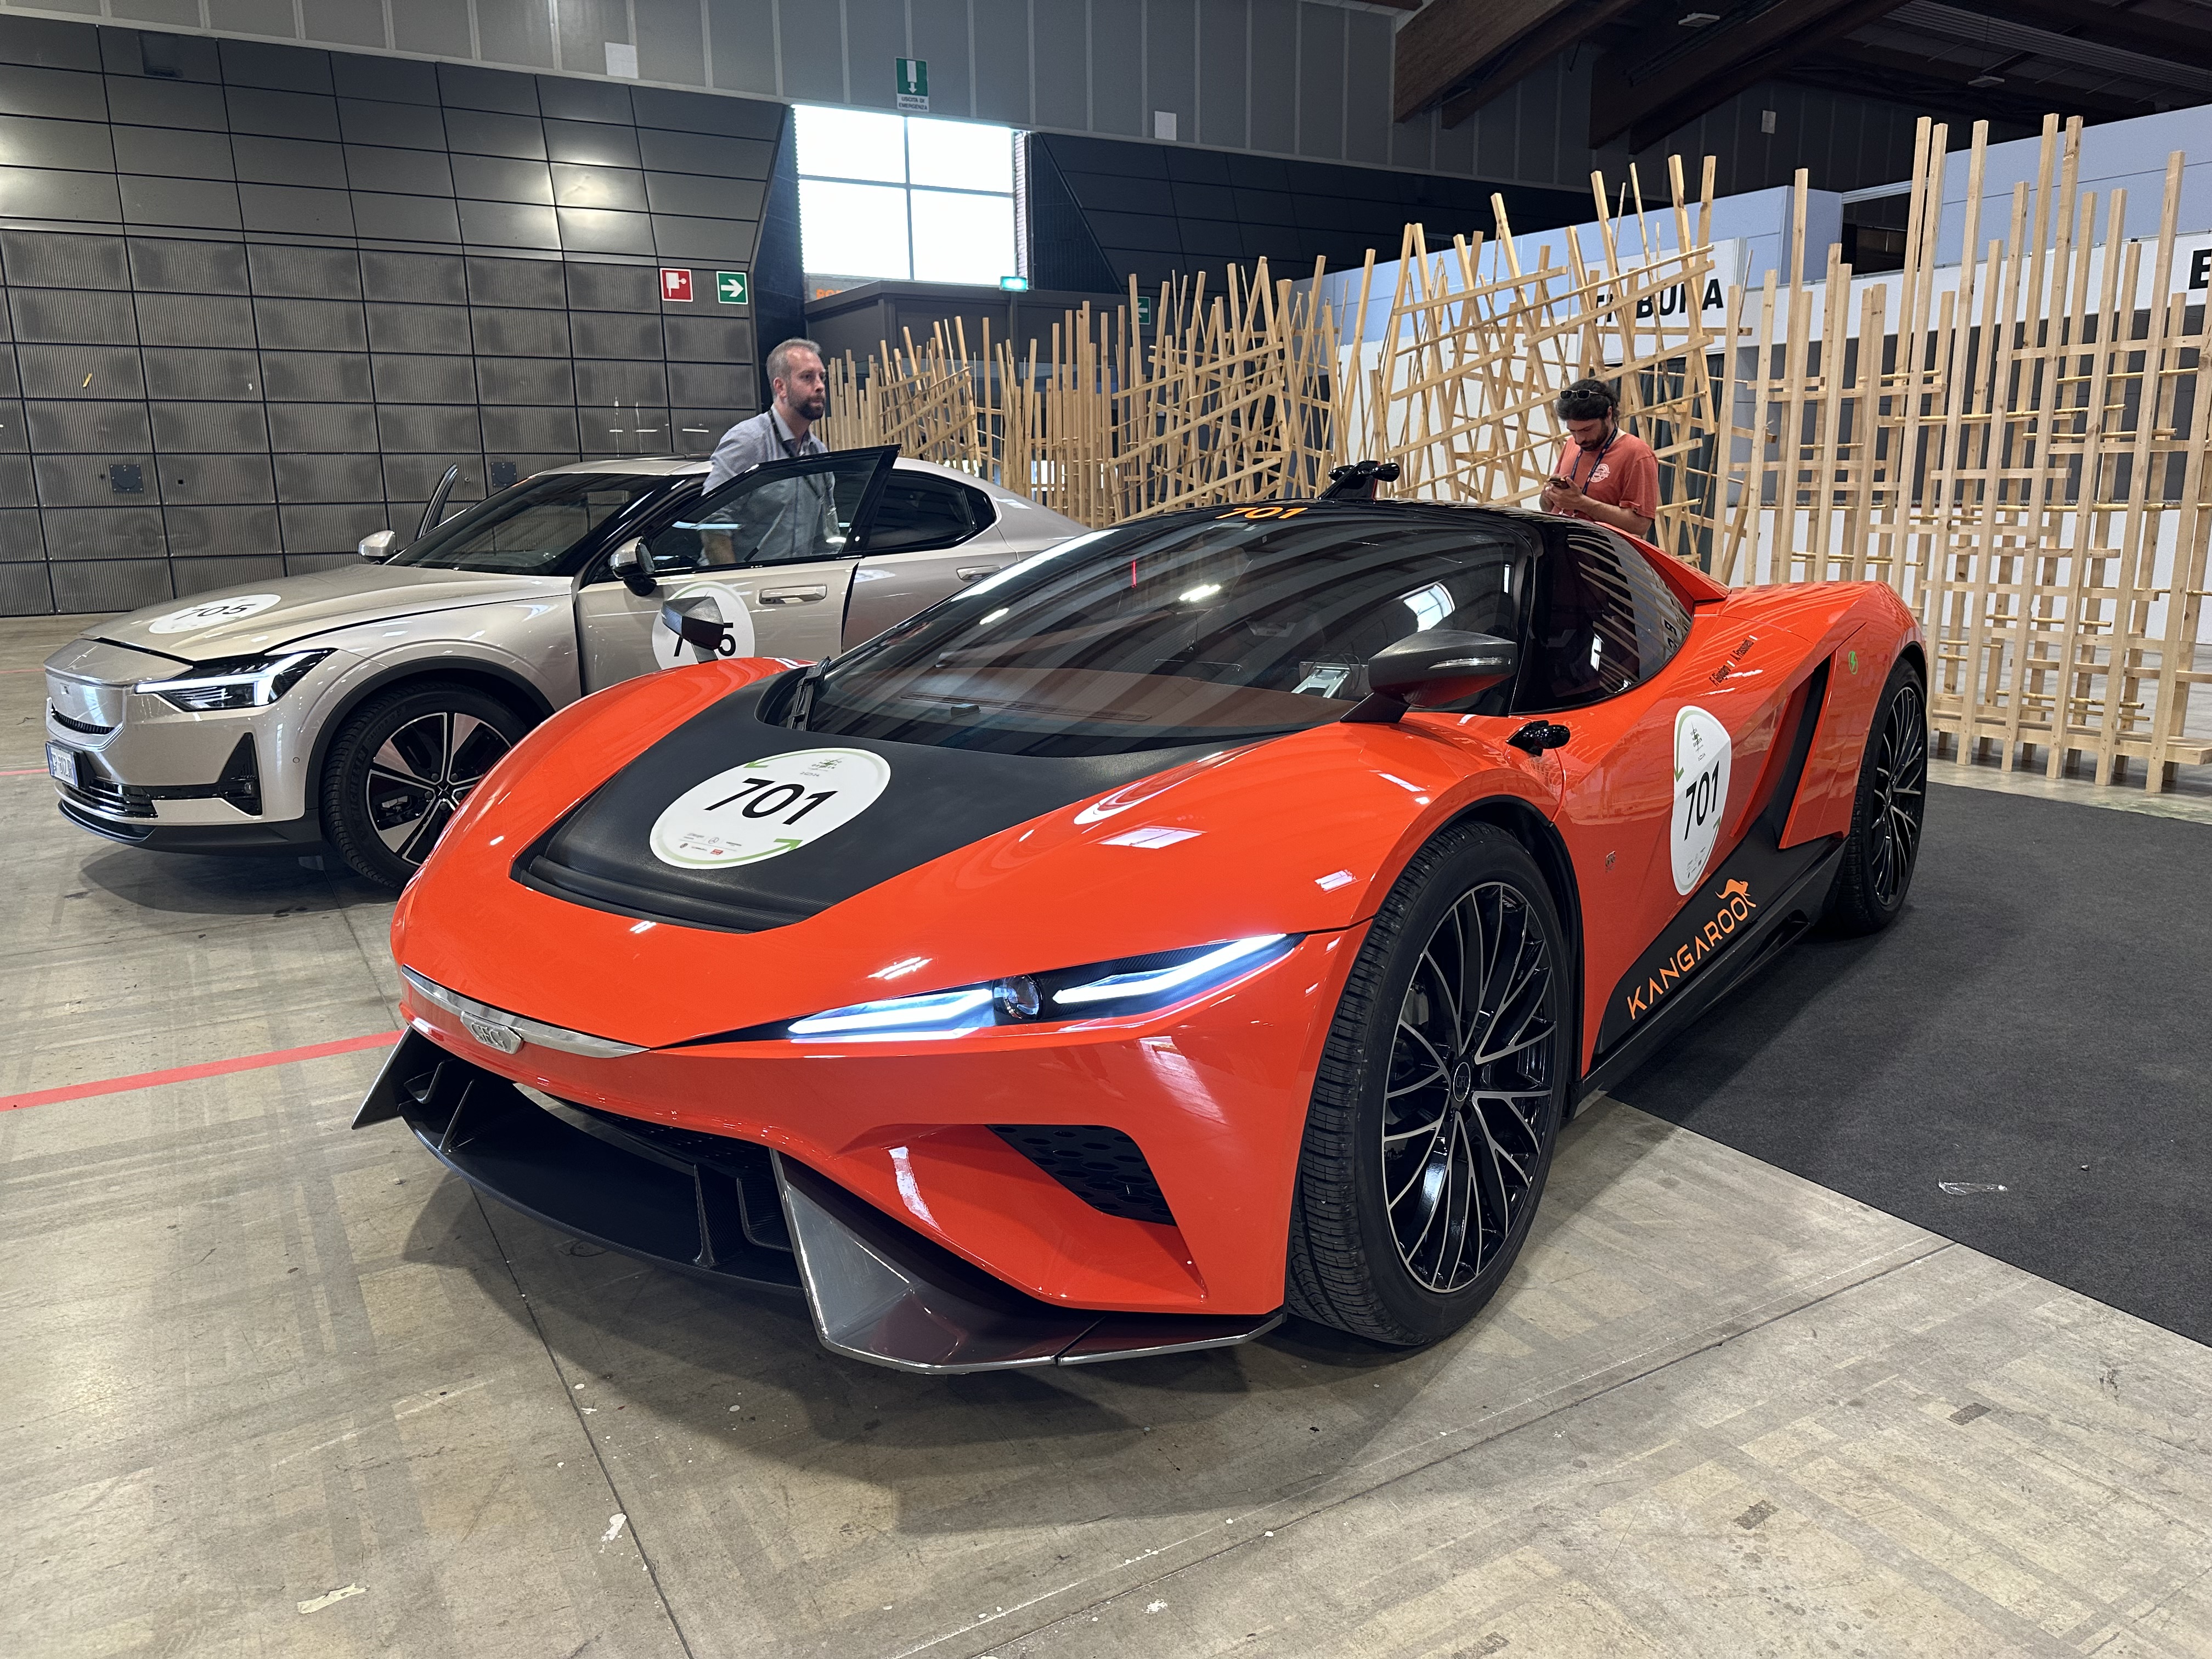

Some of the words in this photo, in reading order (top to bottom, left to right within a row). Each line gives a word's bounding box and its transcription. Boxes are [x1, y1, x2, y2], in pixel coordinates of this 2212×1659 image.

[1215, 507, 1308, 520] 701
[174, 603, 257, 620] 705
[703, 777, 839, 825] 701
[1684, 760, 1720, 842] 701
[1626, 896, 1749, 1020] KANGAROO
[1455, 1075, 1469, 1088] GFG
